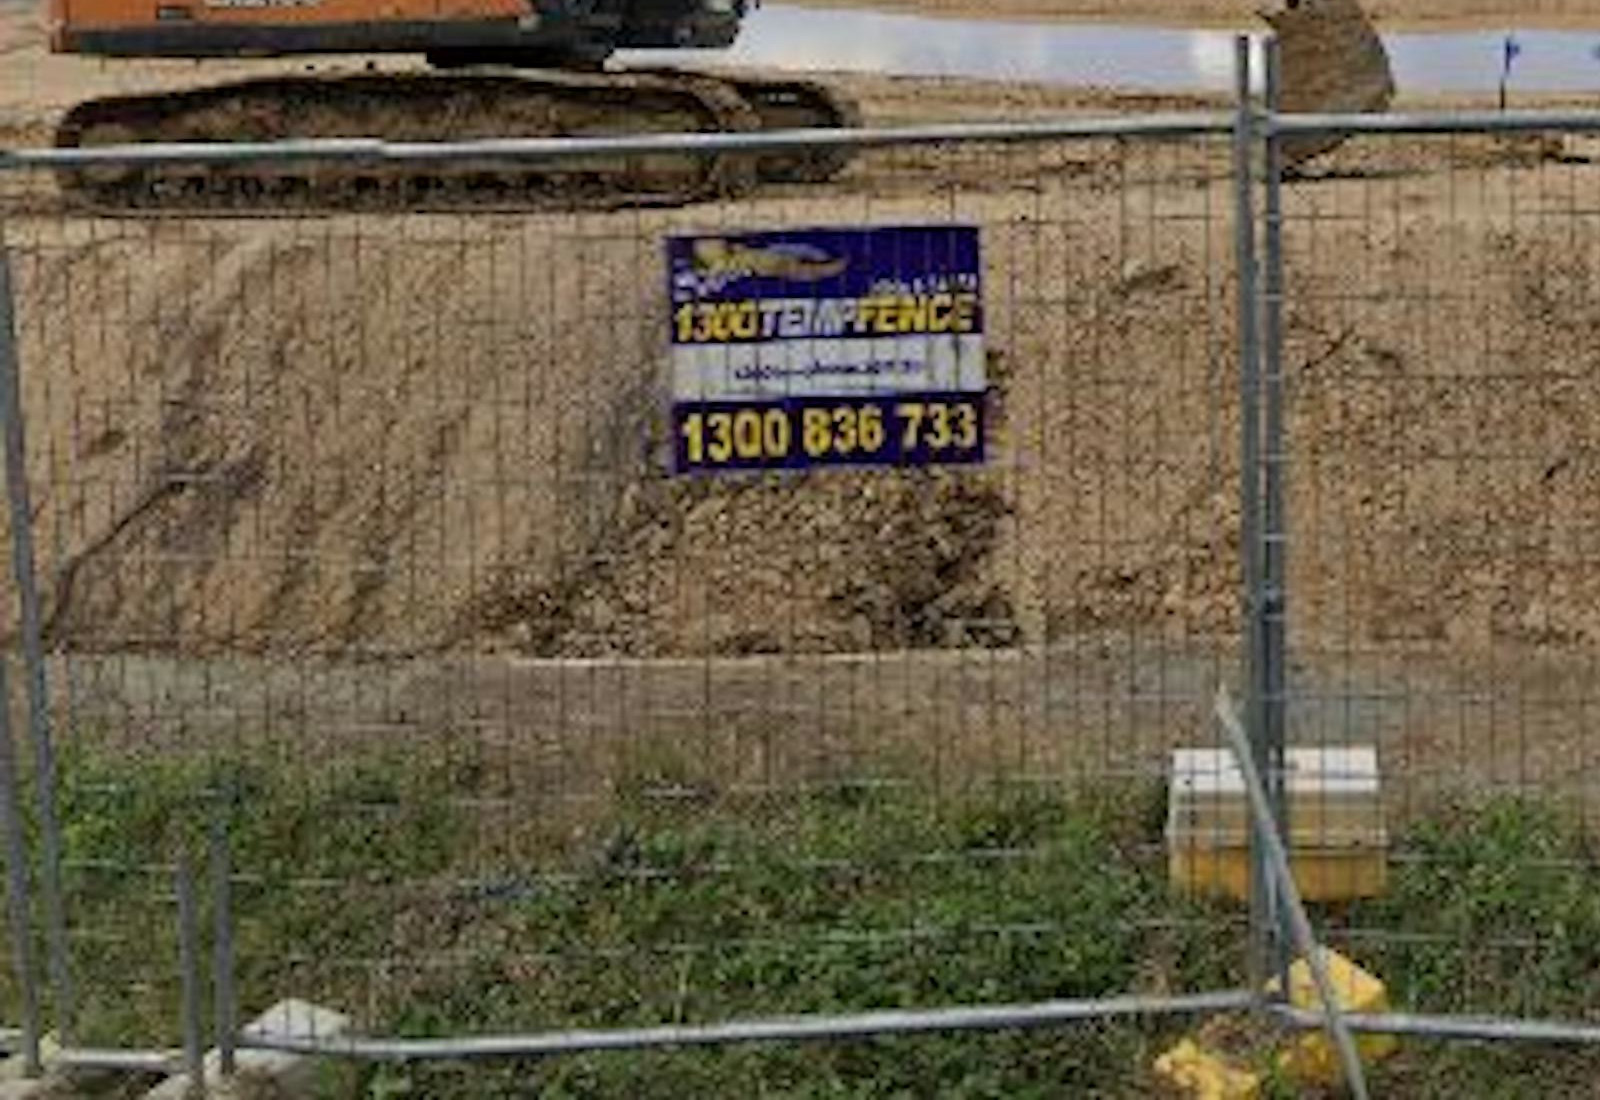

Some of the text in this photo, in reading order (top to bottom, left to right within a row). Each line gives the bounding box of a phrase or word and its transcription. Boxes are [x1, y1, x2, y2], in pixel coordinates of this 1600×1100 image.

[682, 402, 978, 463] 1300 836 733
